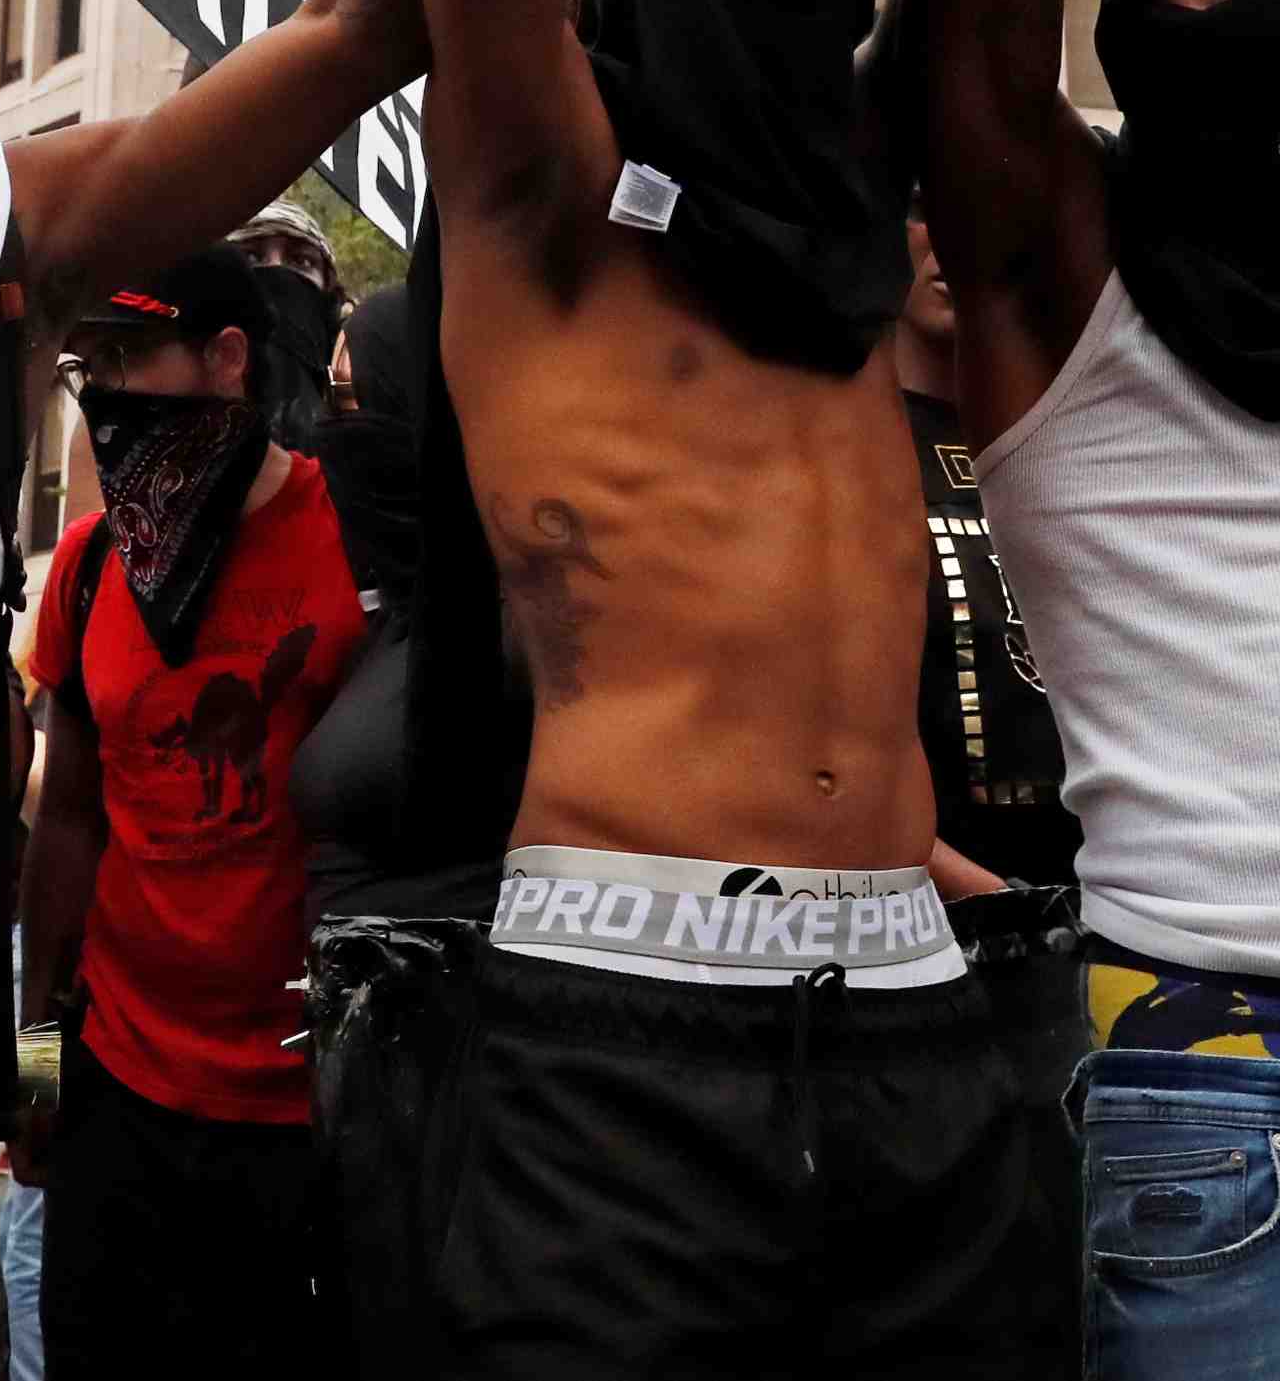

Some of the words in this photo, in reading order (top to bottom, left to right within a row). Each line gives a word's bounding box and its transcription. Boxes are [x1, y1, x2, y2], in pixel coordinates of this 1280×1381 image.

[503, 877, 654, 940] PRO
[663, 891, 839, 957] NIKE
[847, 884, 938, 955] PRO
